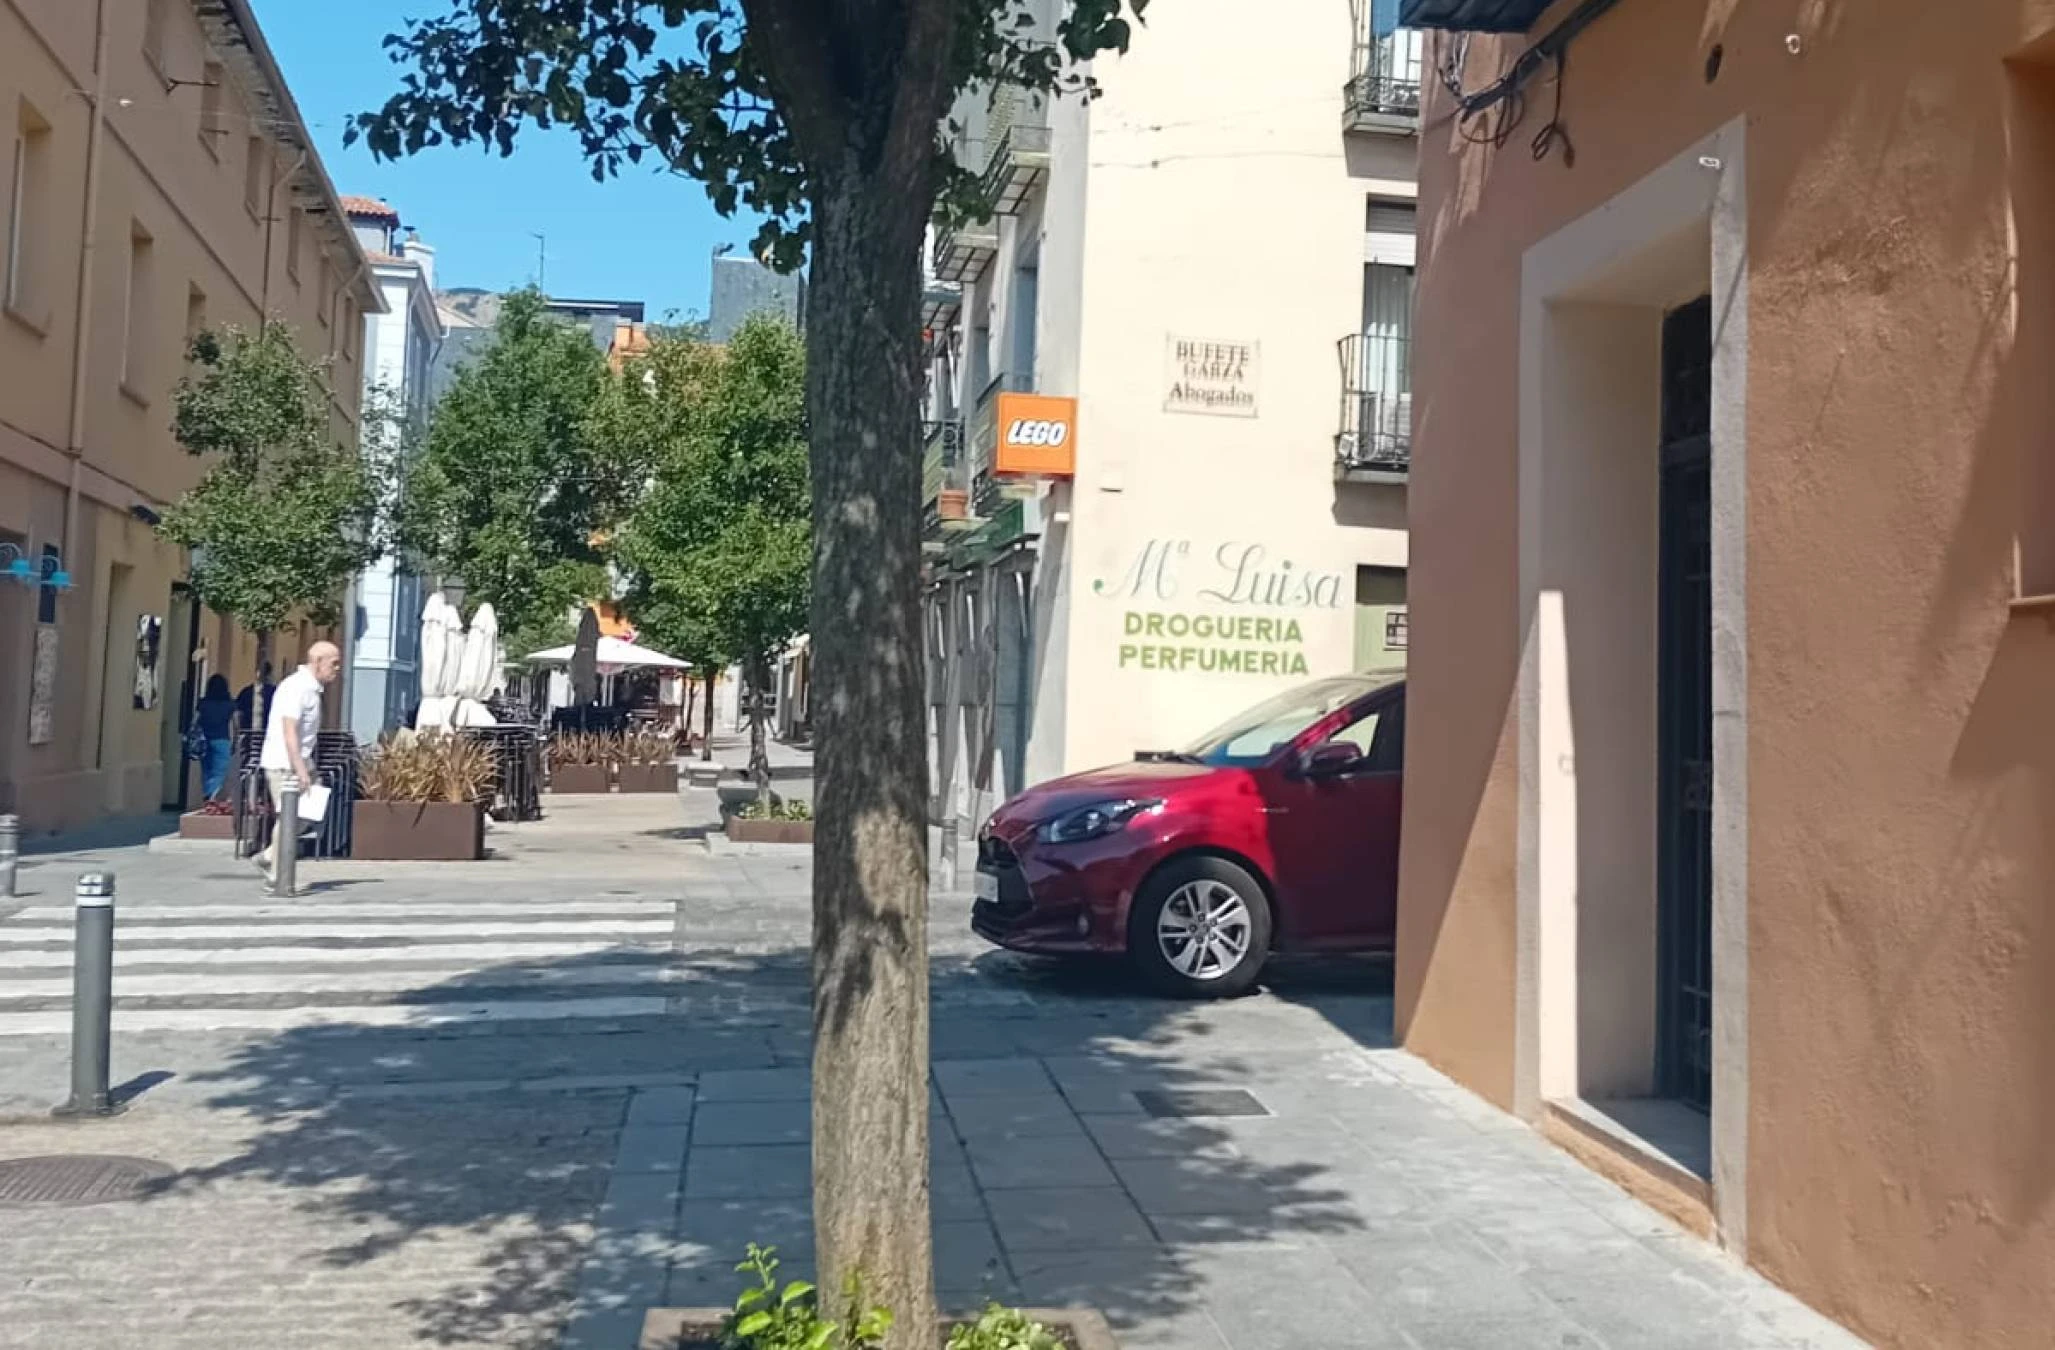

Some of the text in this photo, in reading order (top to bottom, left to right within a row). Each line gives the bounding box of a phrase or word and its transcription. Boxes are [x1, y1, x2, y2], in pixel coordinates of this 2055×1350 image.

[1176, 341, 1249, 366] BUFETE
[1183, 361, 1244, 382] GARZA
[1168, 381, 1254, 408] Abogados
[1007, 418, 1068, 447] LEGO
[1198, 541, 1345, 608] Luisa
[1124, 611, 1303, 643] DROGUERIA
[1118, 644, 1309, 676] PERFUMERIA
